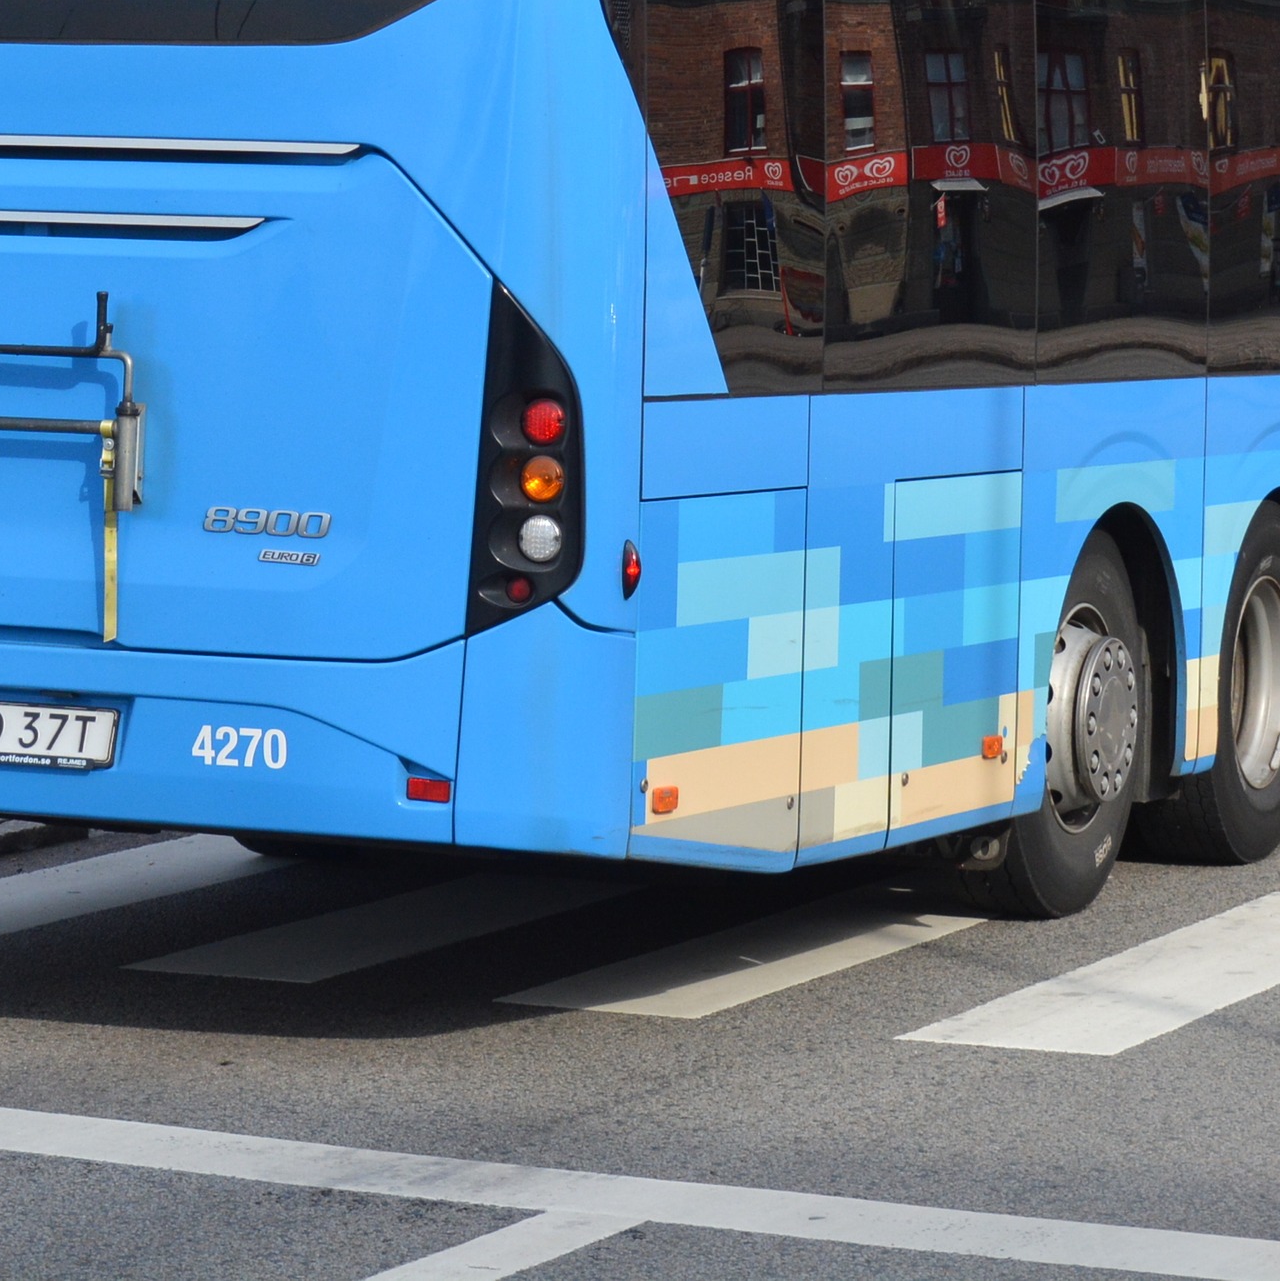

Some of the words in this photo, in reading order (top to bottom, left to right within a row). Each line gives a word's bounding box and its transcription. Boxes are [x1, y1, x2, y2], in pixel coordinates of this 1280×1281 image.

[203, 506, 332, 539] 8900
[261, 550, 300, 562] EURO
[18, 711, 97, 754] 37T
[191, 724, 288, 770] 4270
